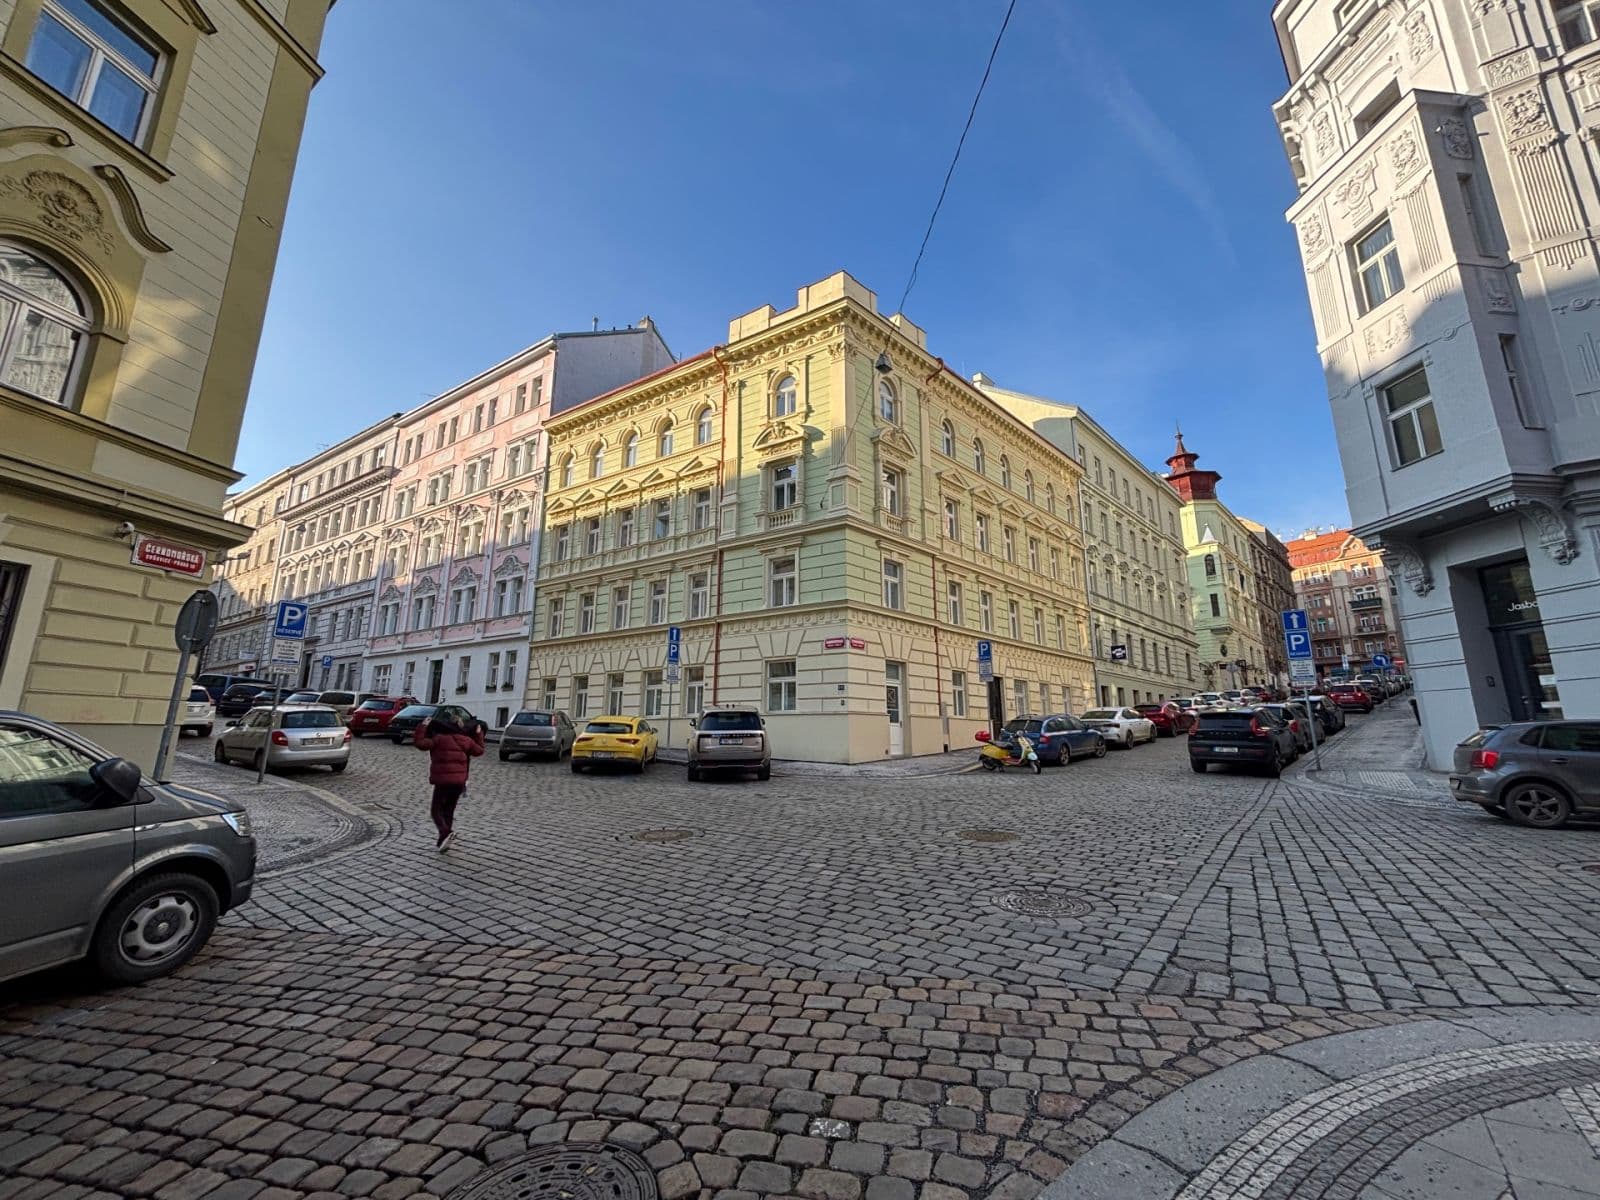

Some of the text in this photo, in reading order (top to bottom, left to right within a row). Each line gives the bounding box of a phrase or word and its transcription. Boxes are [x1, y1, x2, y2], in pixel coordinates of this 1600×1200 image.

[282, 606, 302, 626] P
[1290, 634, 1305, 650] P
[670, 644, 678, 657] P
[980, 643, 989, 656] P
